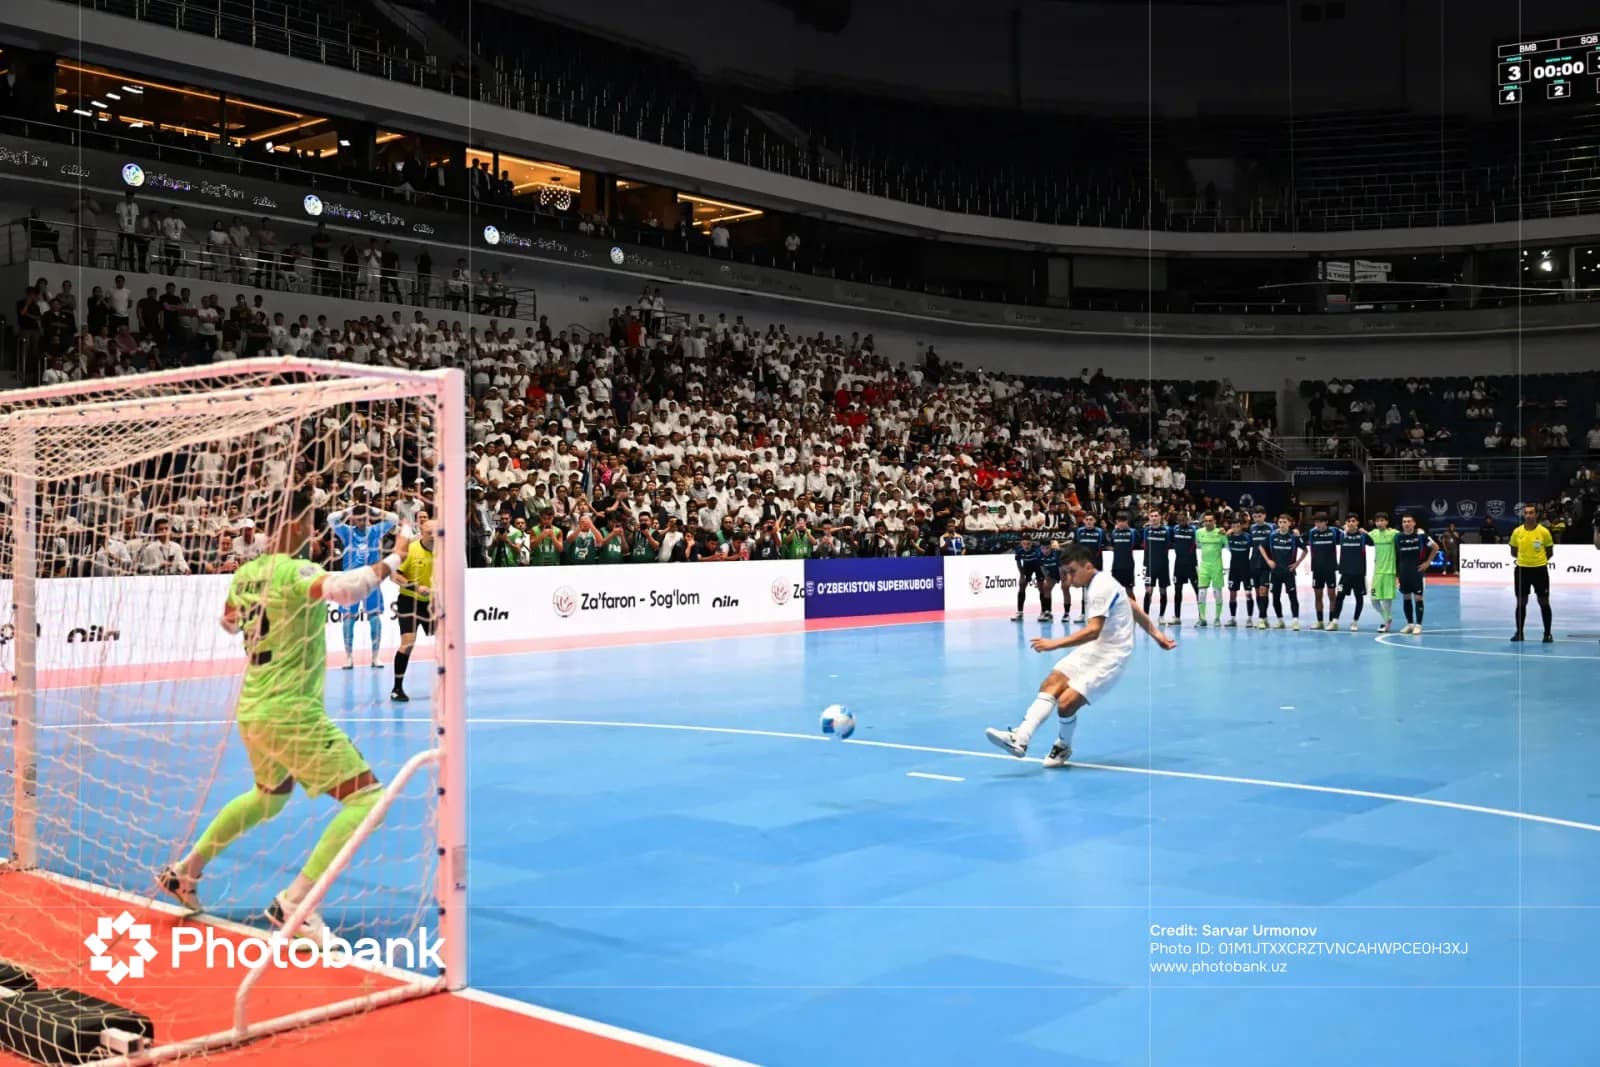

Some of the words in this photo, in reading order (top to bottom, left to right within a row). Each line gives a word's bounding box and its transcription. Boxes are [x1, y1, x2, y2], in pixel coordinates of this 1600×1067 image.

[1580, 35, 1599, 45] SQB
[1507, 65, 1521, 81] 3
[1533, 61, 1585, 79] 00:00
[1505, 91, 1516, 102] 4
[1554, 85, 1564, 96] 2
[1461, 559, 1503, 569] Za'faron
[817, 581, 876, 594] O'ZBEKISTON
[877, 578, 934, 591] SUPERKUBOGI
[985, 575, 1017, 589] Za'faron
[581, 592, 636, 610] Za'faron
[650, 588, 700, 609] Sog'lom
